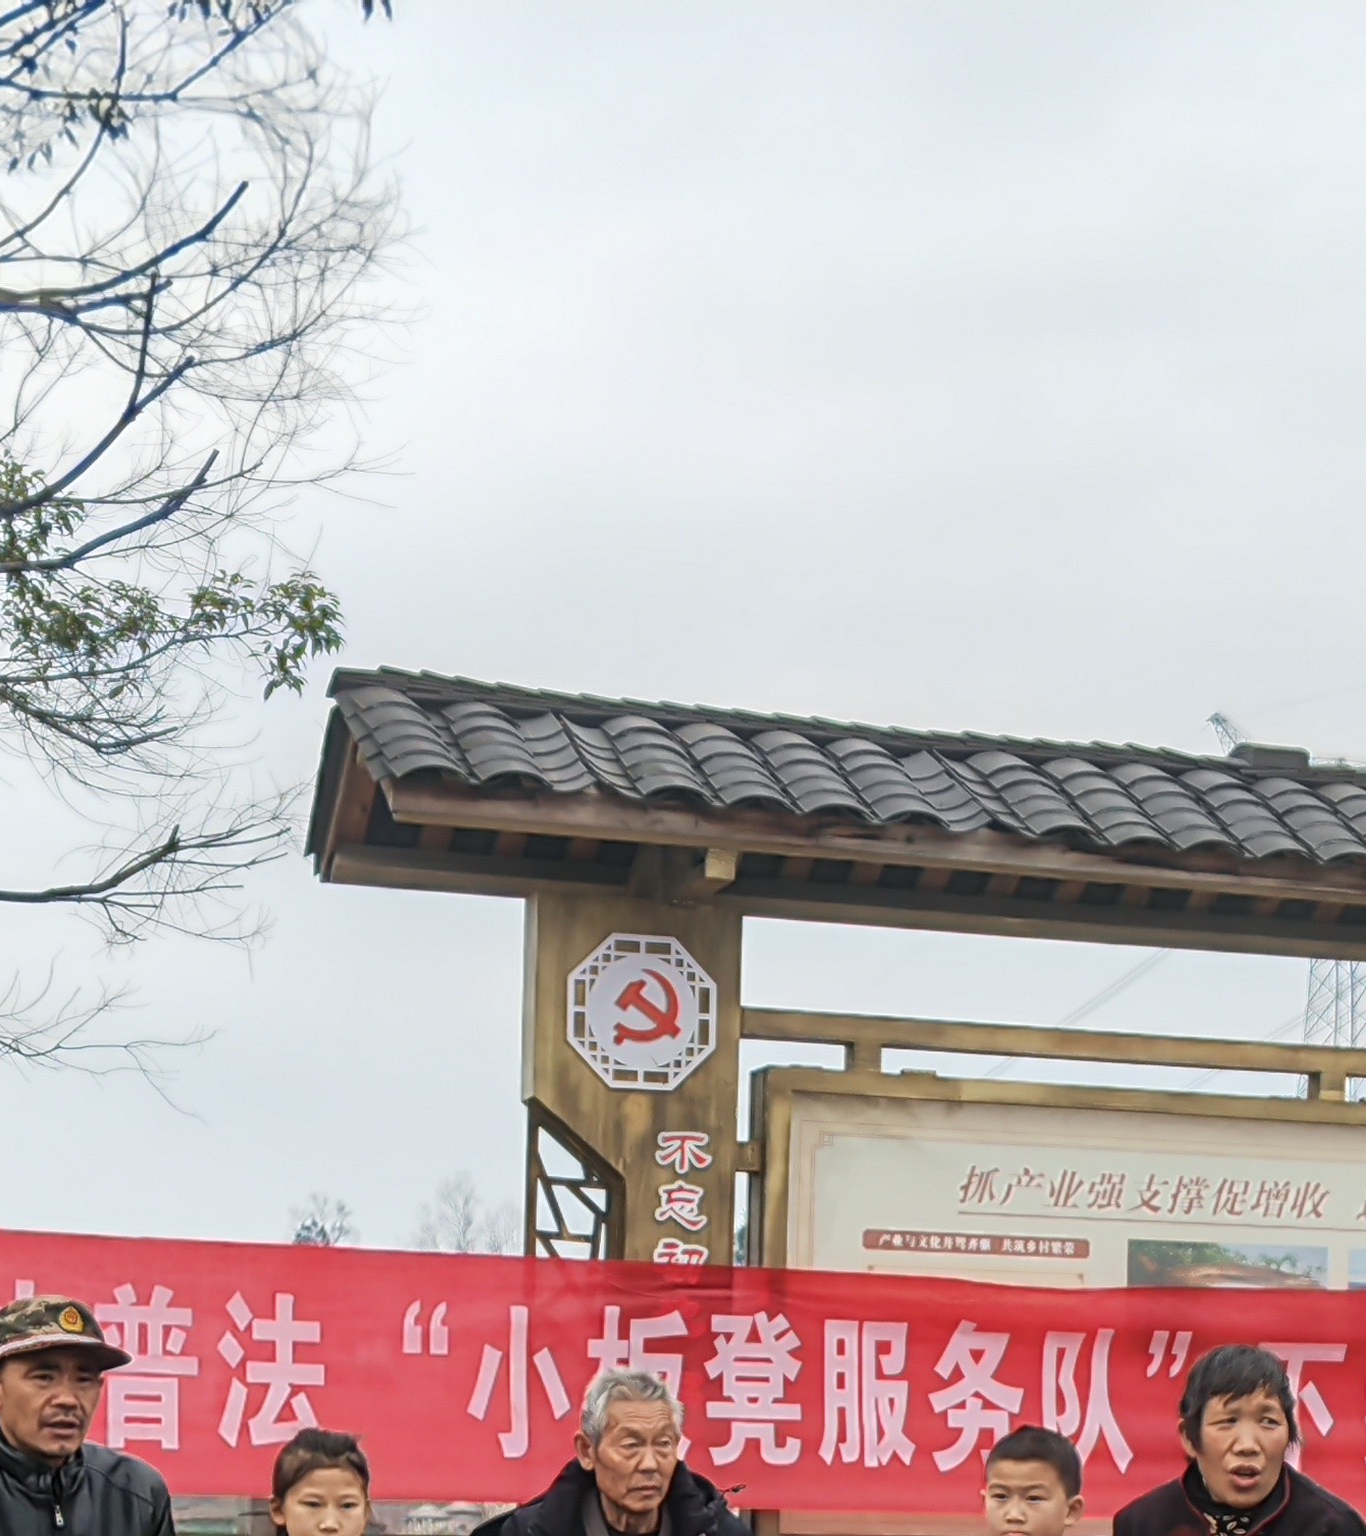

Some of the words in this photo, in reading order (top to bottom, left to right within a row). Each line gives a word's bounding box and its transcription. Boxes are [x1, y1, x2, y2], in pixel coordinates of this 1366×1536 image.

[958, 1164, 1331, 1221] 抓产业强支撑促增收
